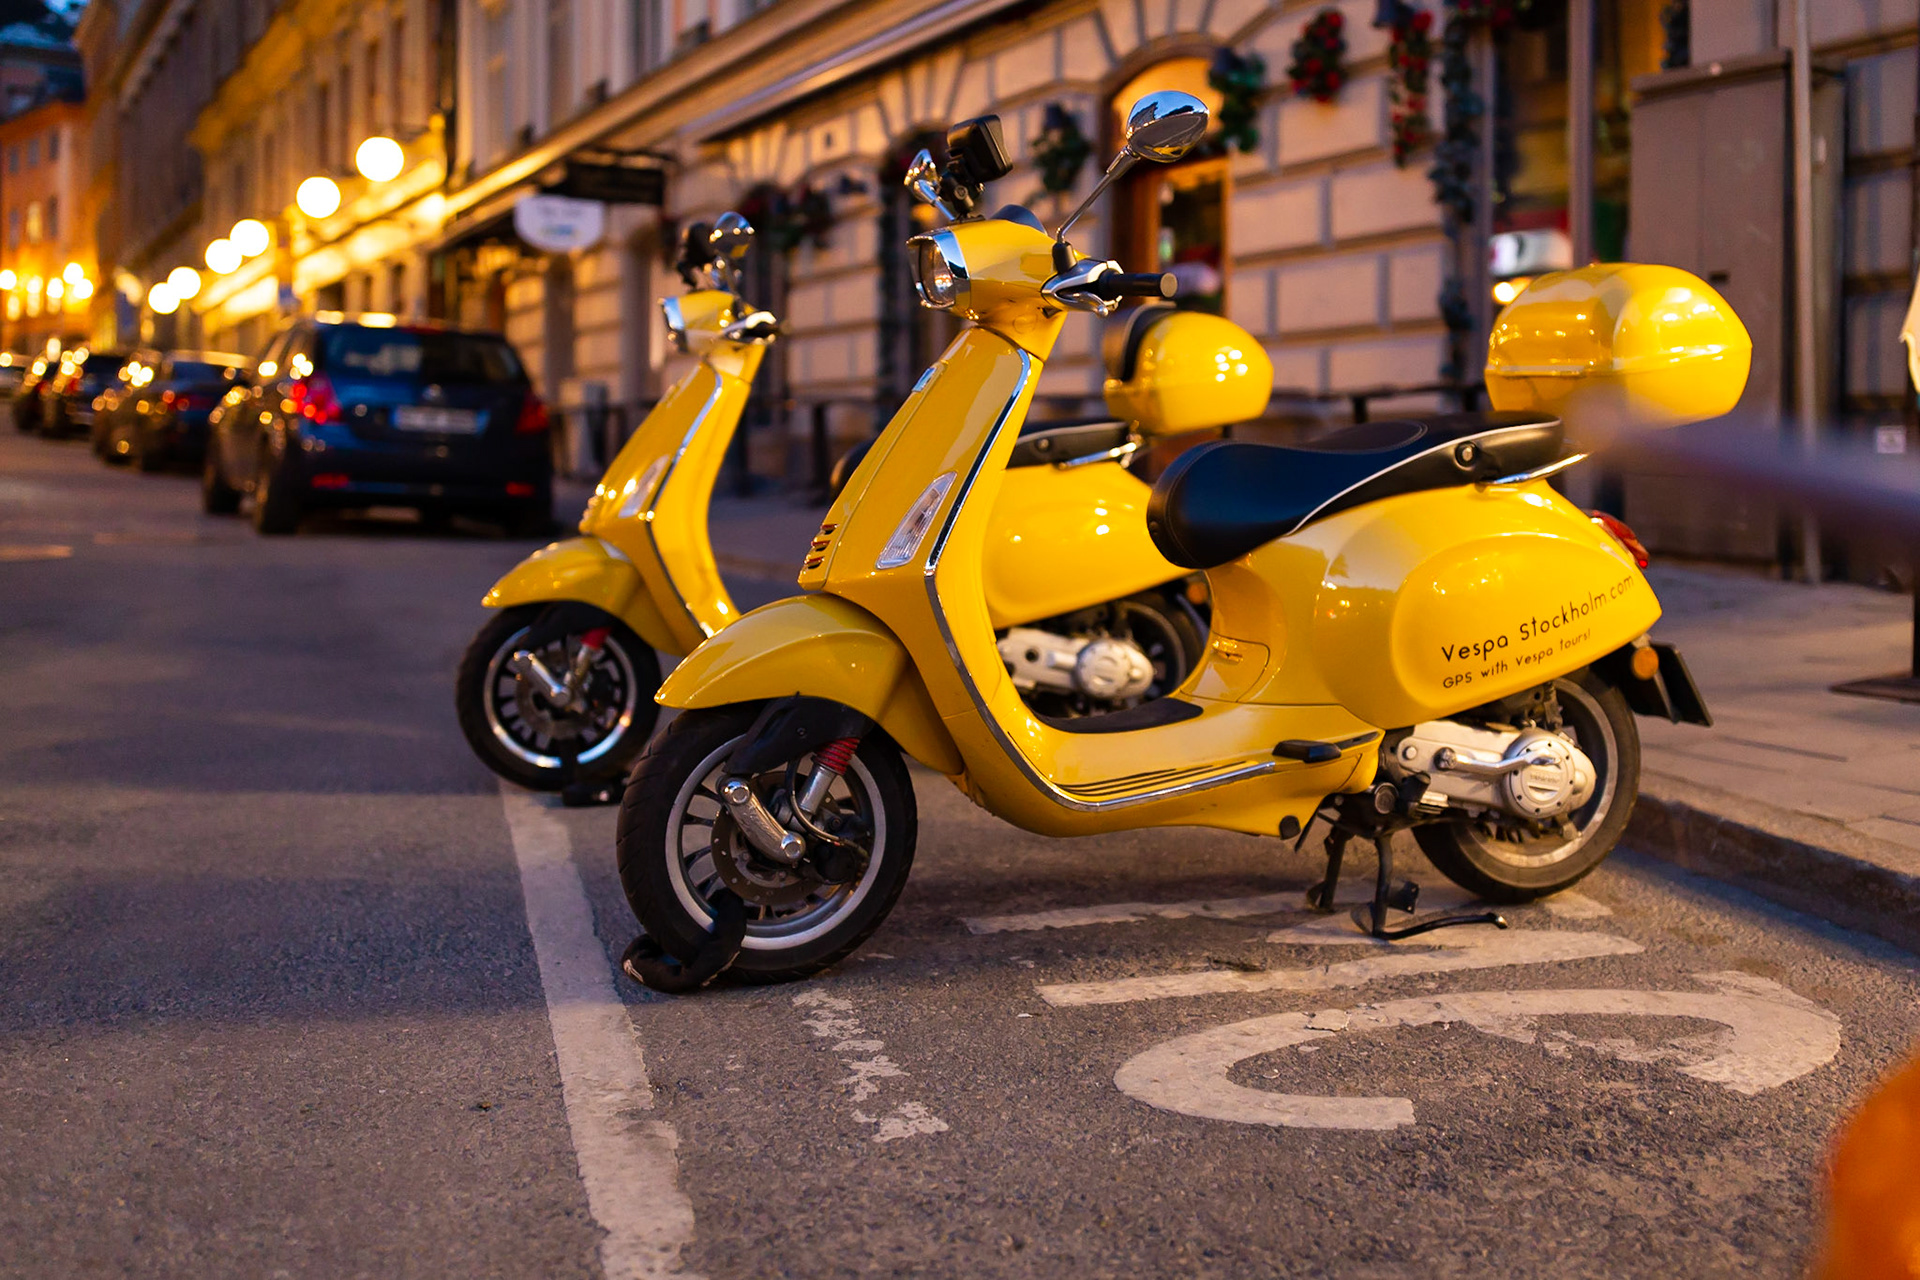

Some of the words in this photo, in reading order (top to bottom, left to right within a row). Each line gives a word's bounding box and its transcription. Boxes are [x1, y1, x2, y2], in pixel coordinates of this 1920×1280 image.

[1441, 635, 1508, 662] Vespa
[1519, 575, 1634, 641] Stockholm.com
[1443, 671, 1472, 689] GPS
[1481, 659, 1508, 678] with
[1516, 648, 1553, 666] Vespa
[1560, 629, 1591, 651] tours!
